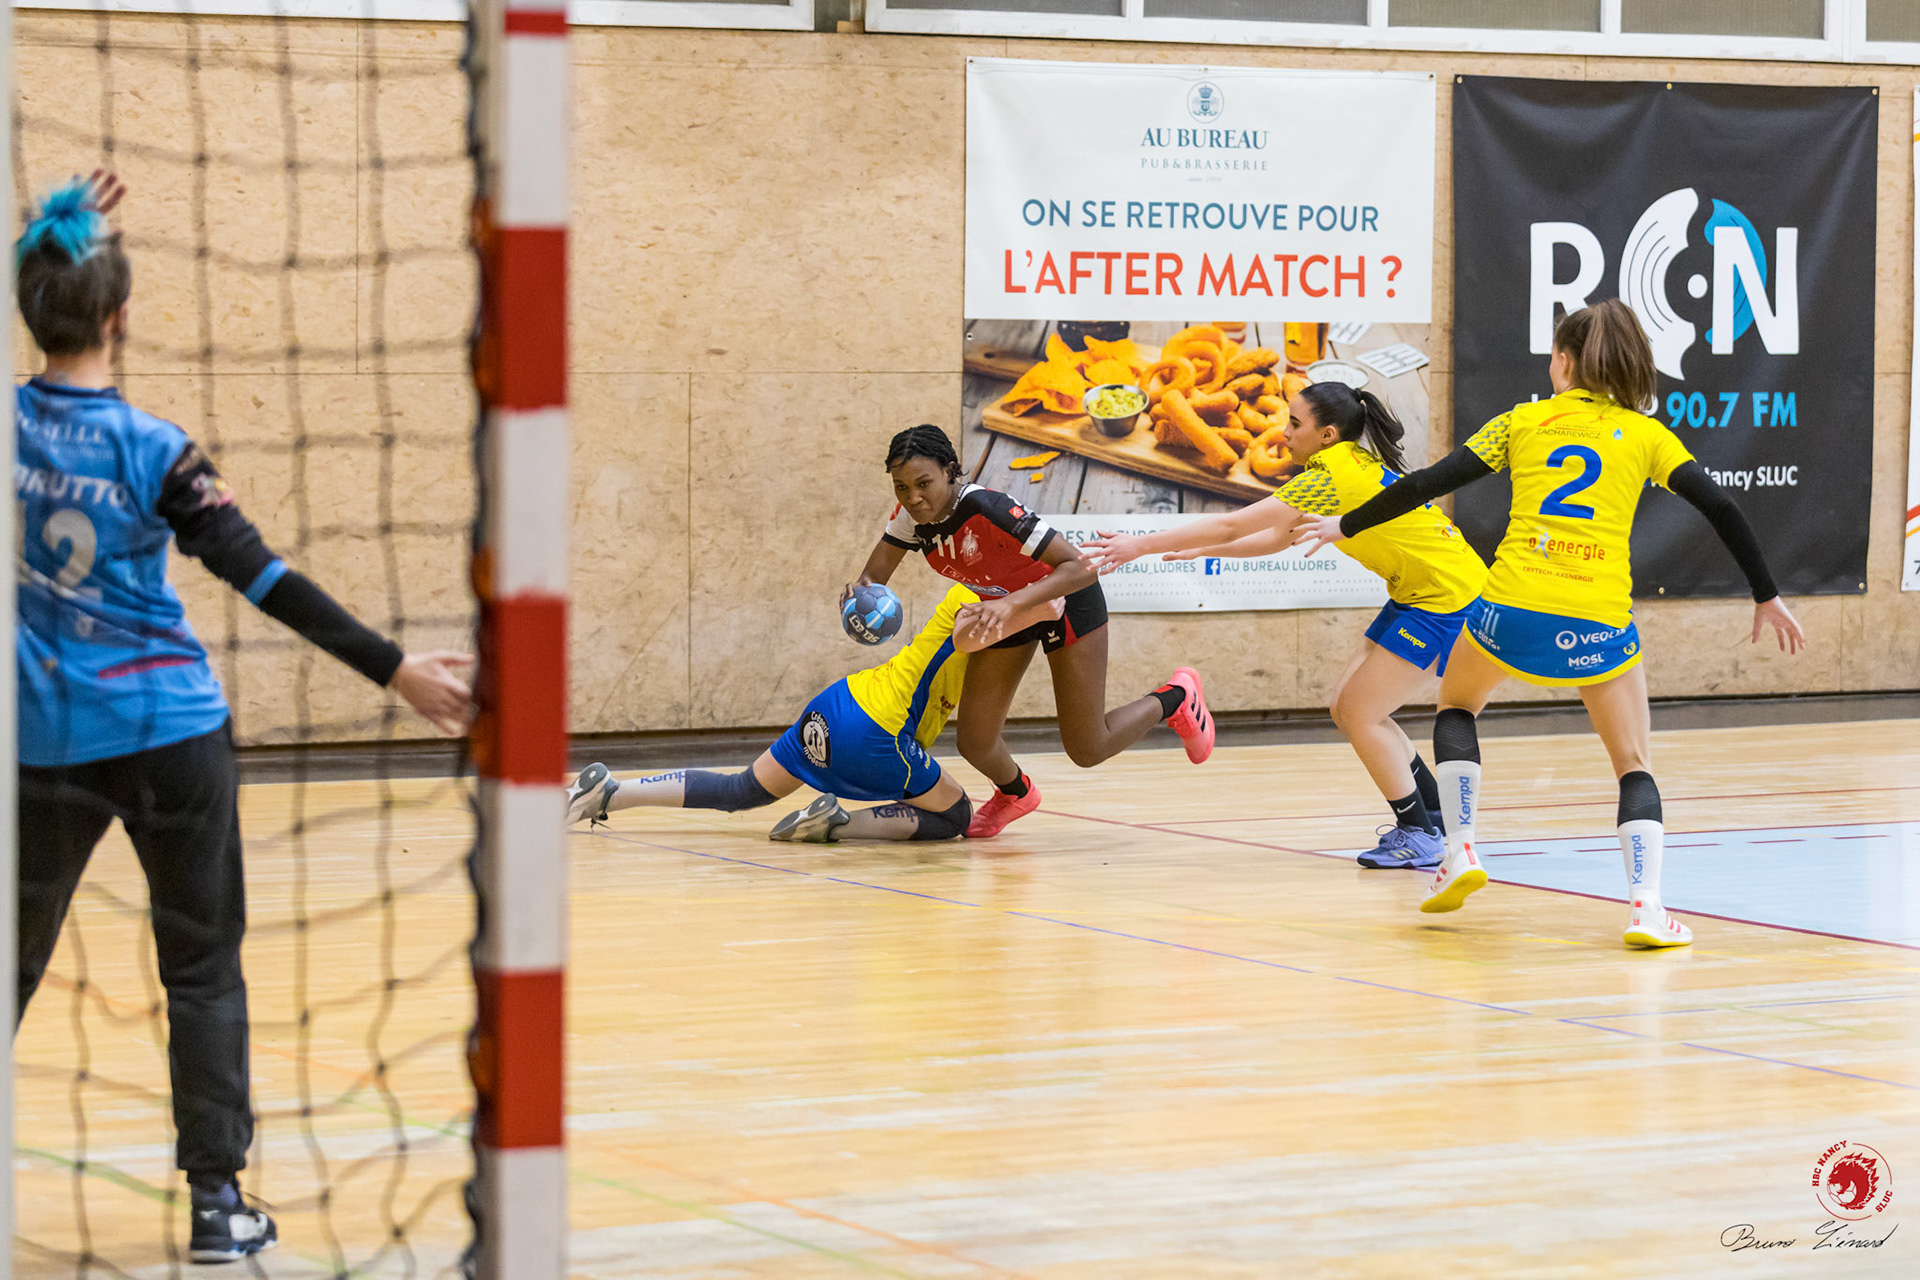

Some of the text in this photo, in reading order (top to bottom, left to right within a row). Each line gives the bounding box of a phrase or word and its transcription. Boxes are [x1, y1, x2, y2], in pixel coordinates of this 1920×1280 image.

[1140, 127, 1268, 150] AU BUREAU
[1141, 157, 1268, 171] PUB&BRASSERIE
[1022, 198, 1379, 232] ON SE RETROUVE POUR
[1004, 250, 1403, 299] L'AFTER MATCH ?
[1666, 391, 1740, 428] 90.7
[1752, 391, 1797, 427] FM
[1538, 444, 1602, 520] 2
[1704, 465, 1798, 491] ancy SLUC
[932, 534, 956, 559] 11
[1223, 561, 1240, 572] AU
[1243, 561, 1289, 572] BUREAU
[1292, 560, 1337, 571] LUDRES
[1398, 627, 1426, 649] Kempa
[1568, 653, 1604, 667] MOSL
[640, 771, 686, 784] Kemp
[872, 804, 918, 823] Kemp
[1459, 776, 1472, 826] Kempa
[1632, 834, 1643, 885] Kempa
